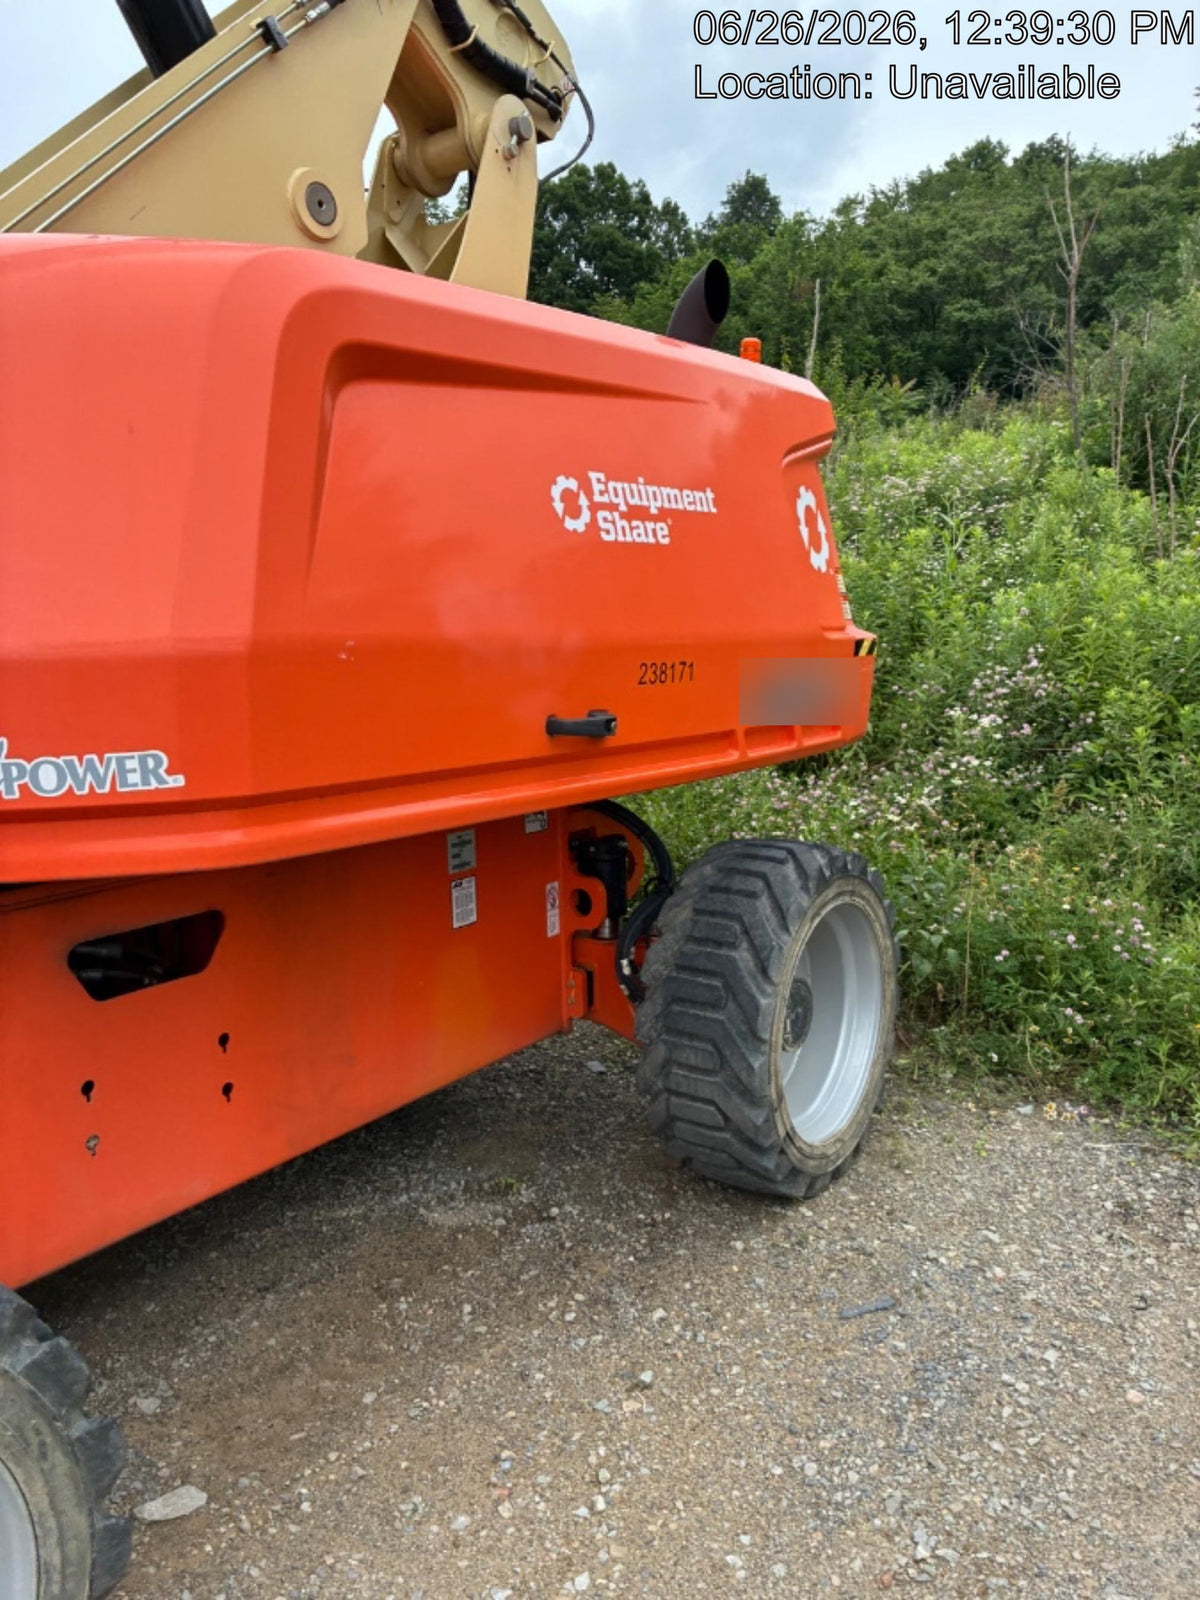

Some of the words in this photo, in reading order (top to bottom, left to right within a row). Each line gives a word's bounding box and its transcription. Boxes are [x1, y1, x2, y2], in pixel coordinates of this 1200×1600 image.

[588, 471, 717, 513] Equipment
[597, 511, 670, 544] Share
[638, 661, 695, 685] 238171
[0, 739, 171, 798] POWER
